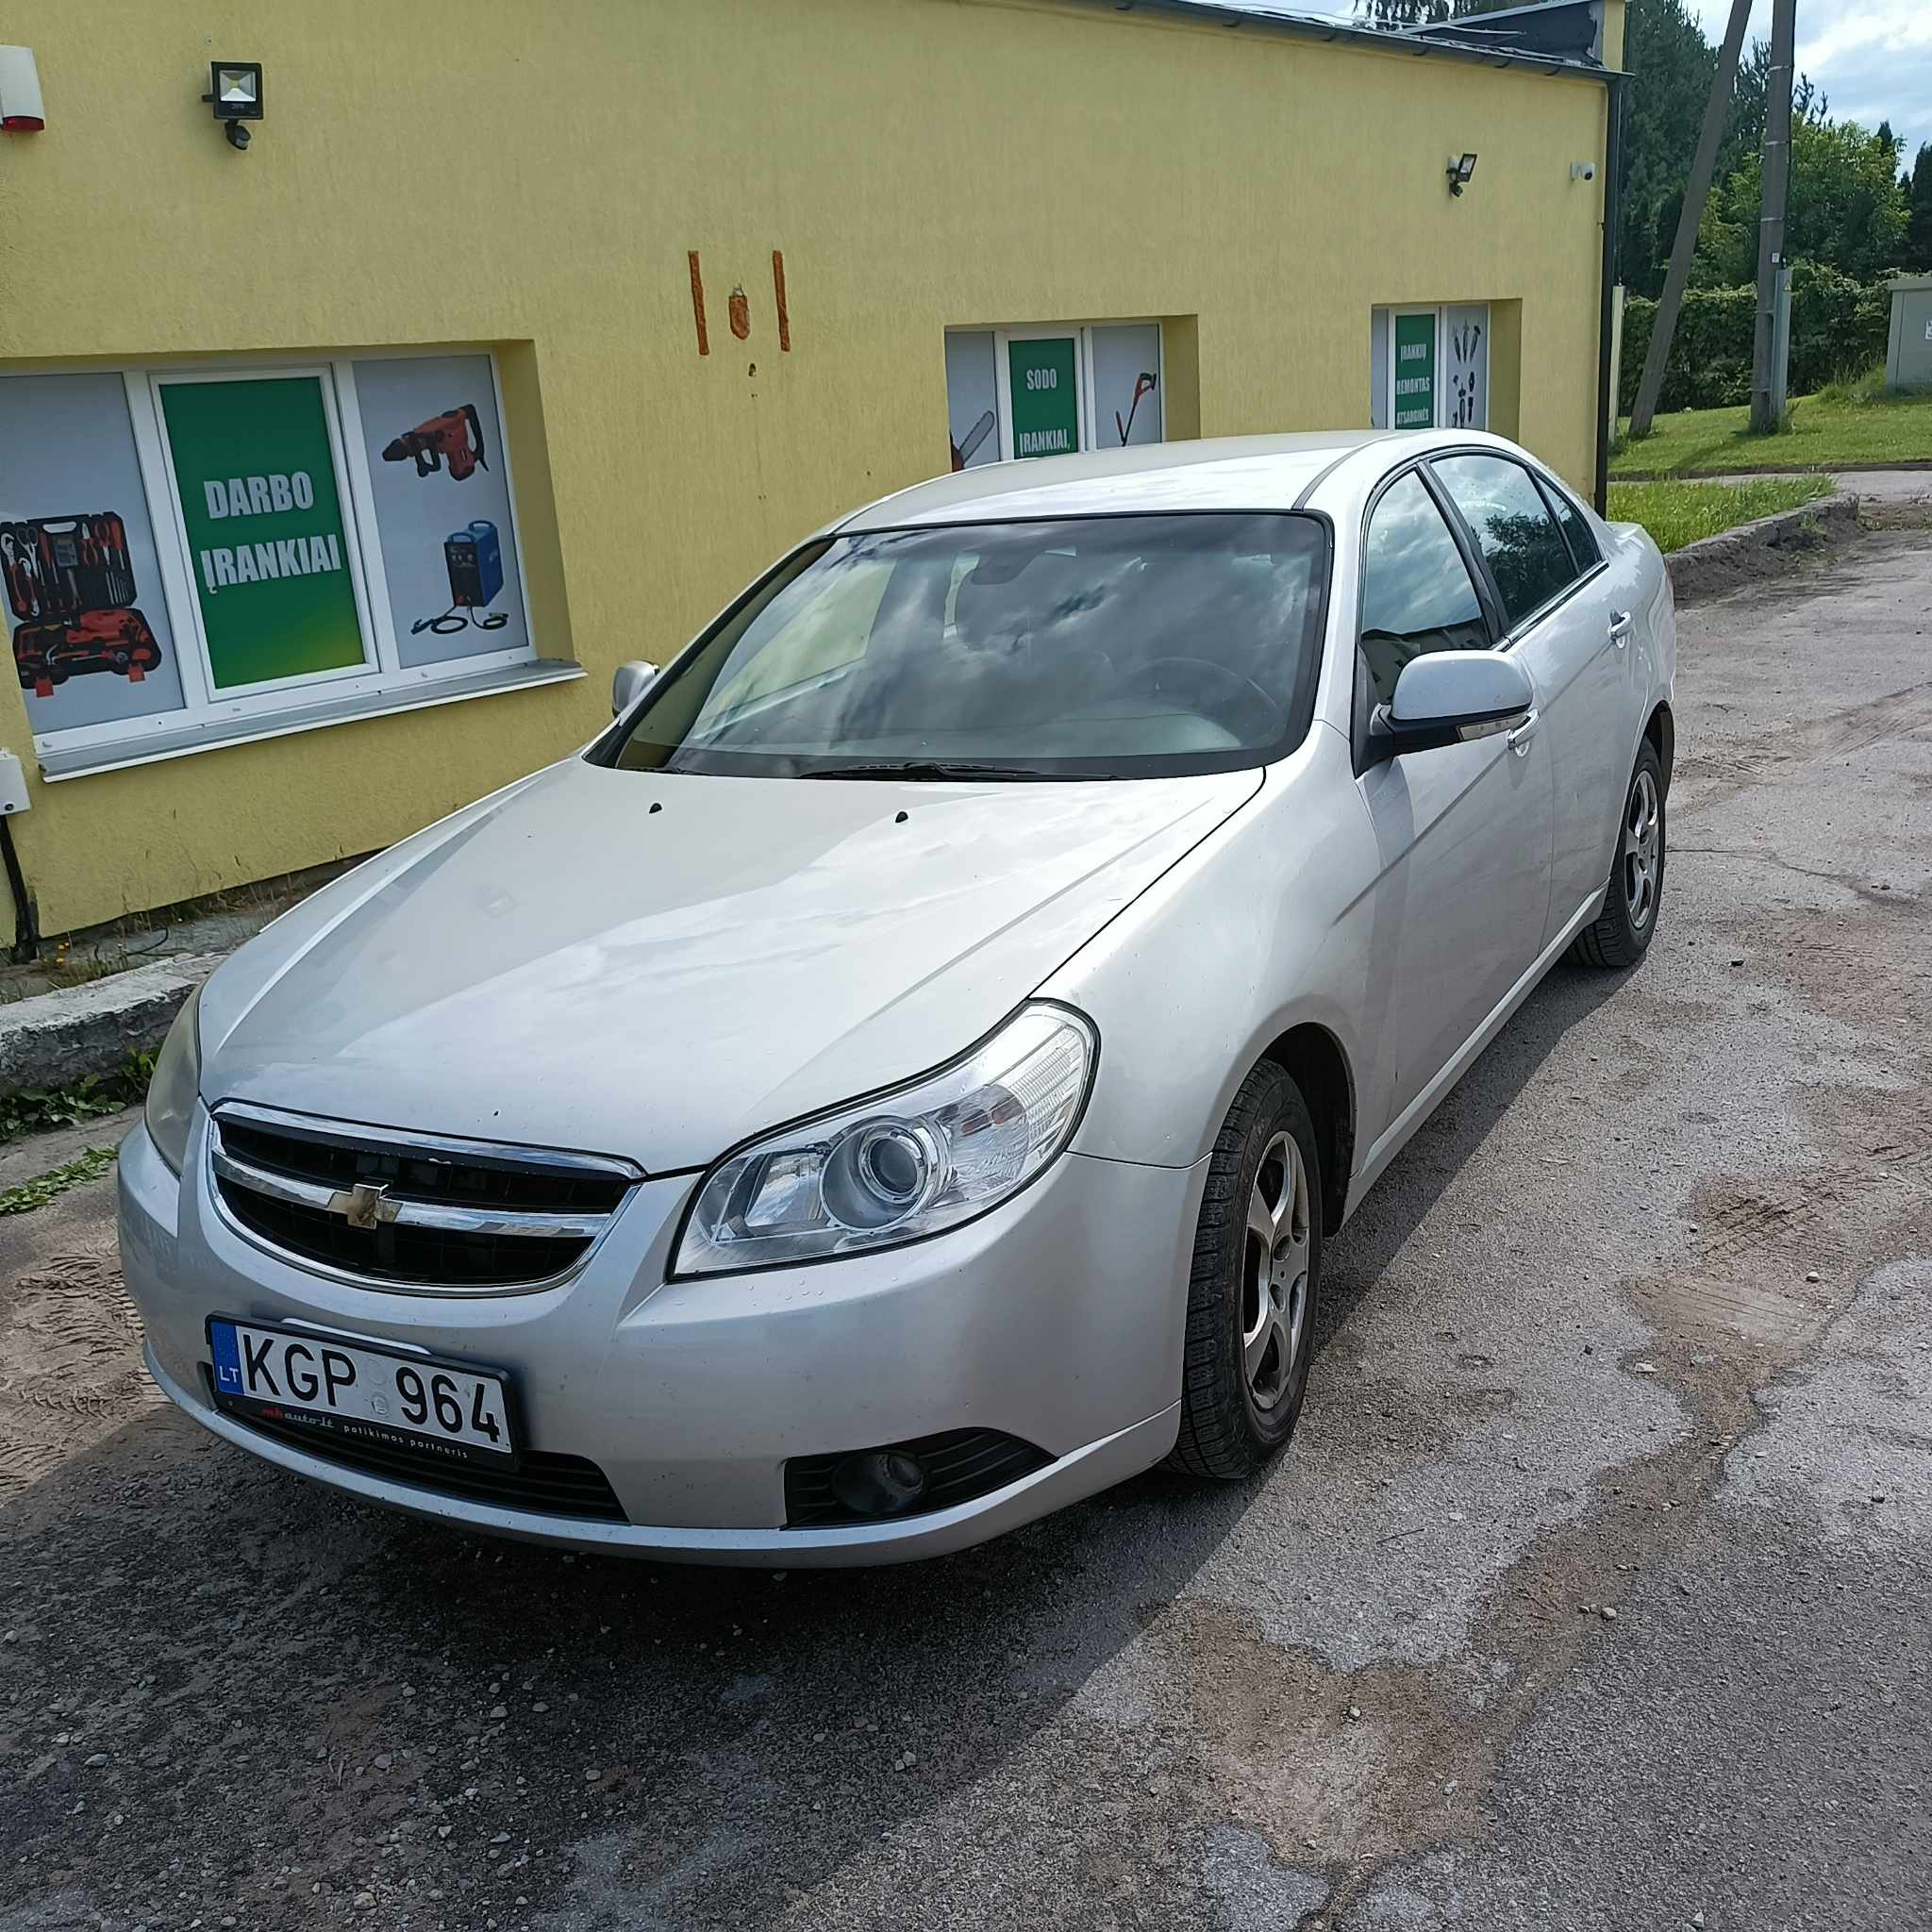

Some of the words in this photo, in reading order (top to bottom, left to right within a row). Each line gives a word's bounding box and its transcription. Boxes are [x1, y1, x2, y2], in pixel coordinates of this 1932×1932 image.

[1026, 368, 1057, 391] SODO
[203, 472, 314, 520] DARBO
[200, 534, 341, 593] ĮRANKIAI
[218, 1364, 239, 1385] LT
[242, 1334, 357, 1407] KGP
[395, 1366, 500, 1443] 964
[343, 1424, 404, 1444] patikimas
[410, 1438, 469, 1459] partneris
